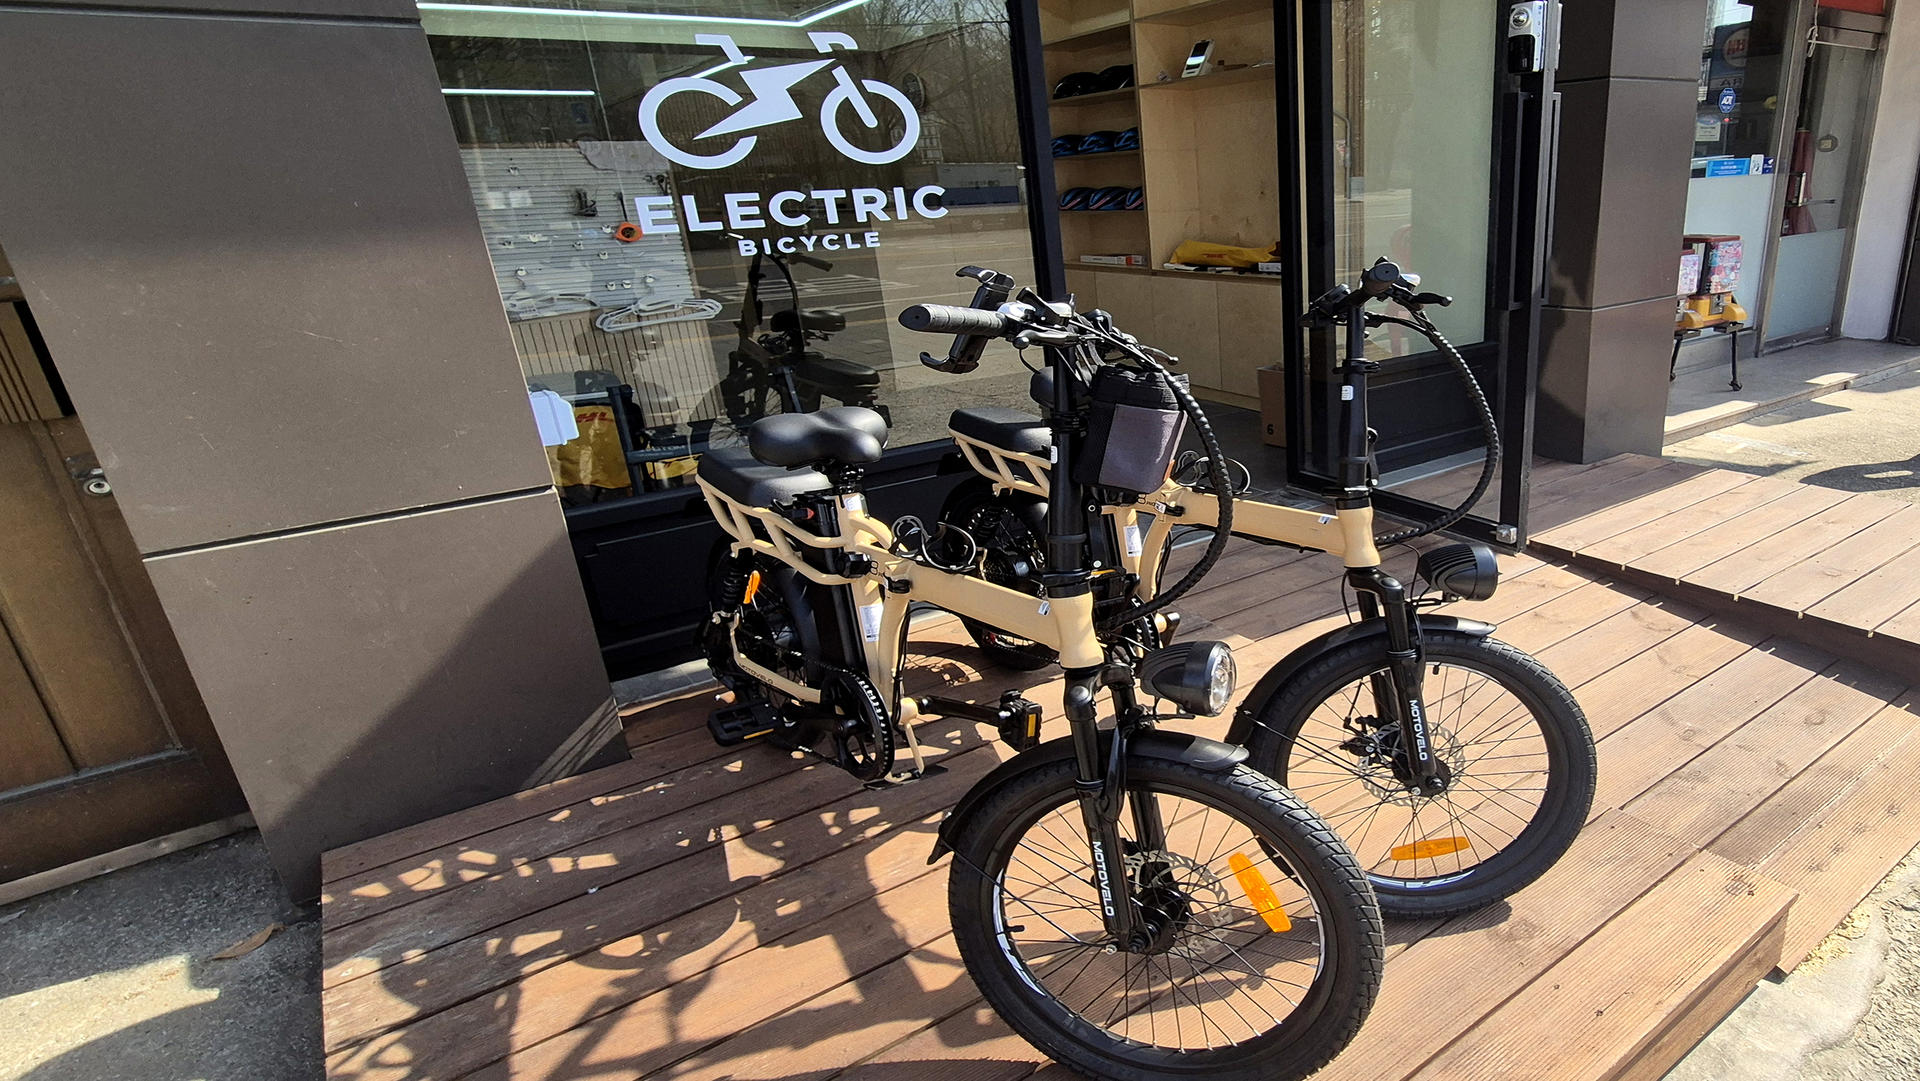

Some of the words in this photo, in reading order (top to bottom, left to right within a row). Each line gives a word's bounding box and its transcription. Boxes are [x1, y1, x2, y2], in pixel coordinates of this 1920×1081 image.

[634, 185, 949, 235] ELECTRIC
[737, 231, 881, 257] BICYCLE
[1267, 424, 1274, 435] 6
[1409, 699, 1428, 761] MOTOVELO
[1092, 841, 1115, 917] MOTOVELO
